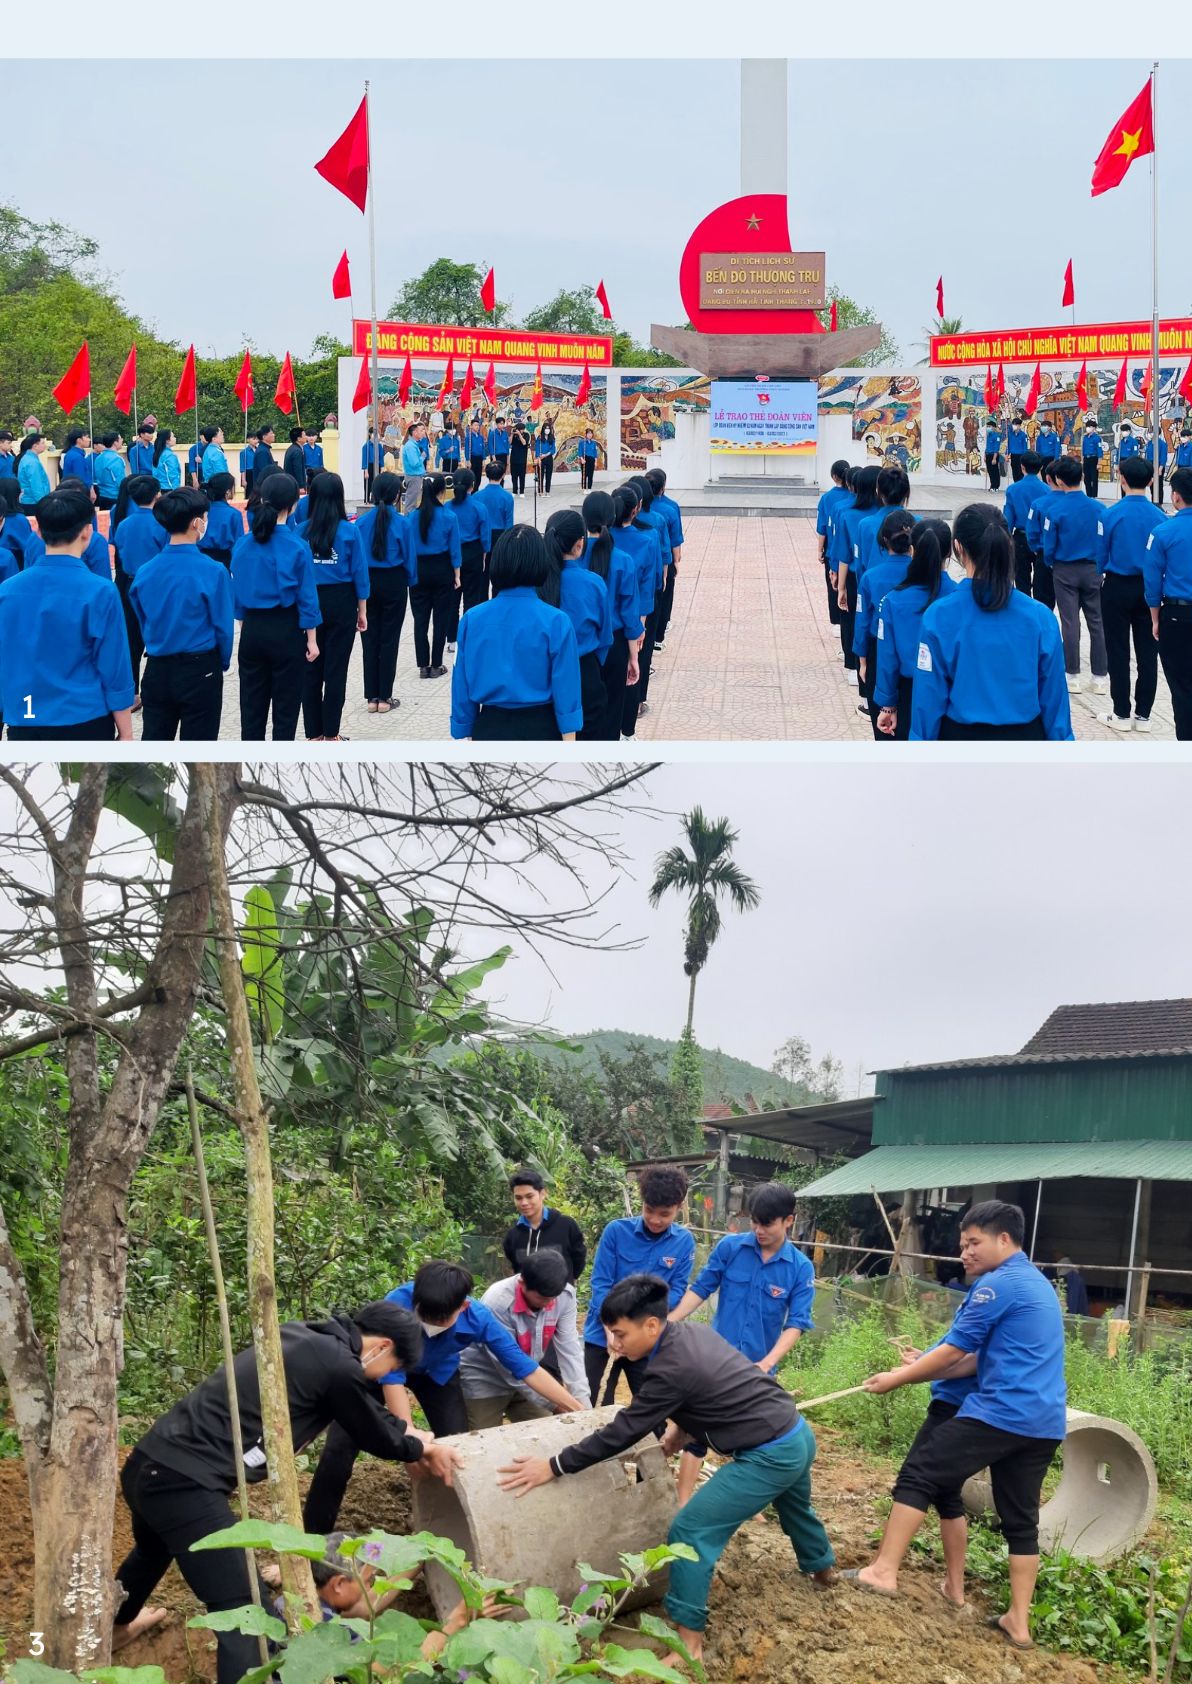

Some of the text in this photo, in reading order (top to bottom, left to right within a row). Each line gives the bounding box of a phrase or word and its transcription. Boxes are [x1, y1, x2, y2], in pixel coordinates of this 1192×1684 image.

[705, 266, 820, 287] BẾN ĐÒ THƯỢNG TRỤ
[400, 331, 430, 354] CỘNG
[432, 330, 454, 352] SẢN
[456, 336, 478, 357] VIỆT
[479, 339, 502, 355] NAM
[504, 341, 535, 357] QUANG
[537, 343, 558, 358] VINH
[560, 342, 585, 359] MUÔN
[586, 343, 605, 360] NĂM
[938, 340, 956, 360] NƯỚC
[957, 340, 976, 363] CỘNG
[976, 338, 991, 358] HÒA
[991, 337, 1002, 357] XÃ
[1003, 336, 1016, 360] HỘI
[1017, 332, 1033, 356] CHỦ
[1034, 334, 1058, 355] NGHĨA
[1059, 333, 1076, 357] VIỆT
[1078, 335, 1097, 353] NAM
[1099, 334, 1129, 354] QUANG
[1131, 331, 1152, 350] VINH
[726, 412, 748, 421] TRAO
